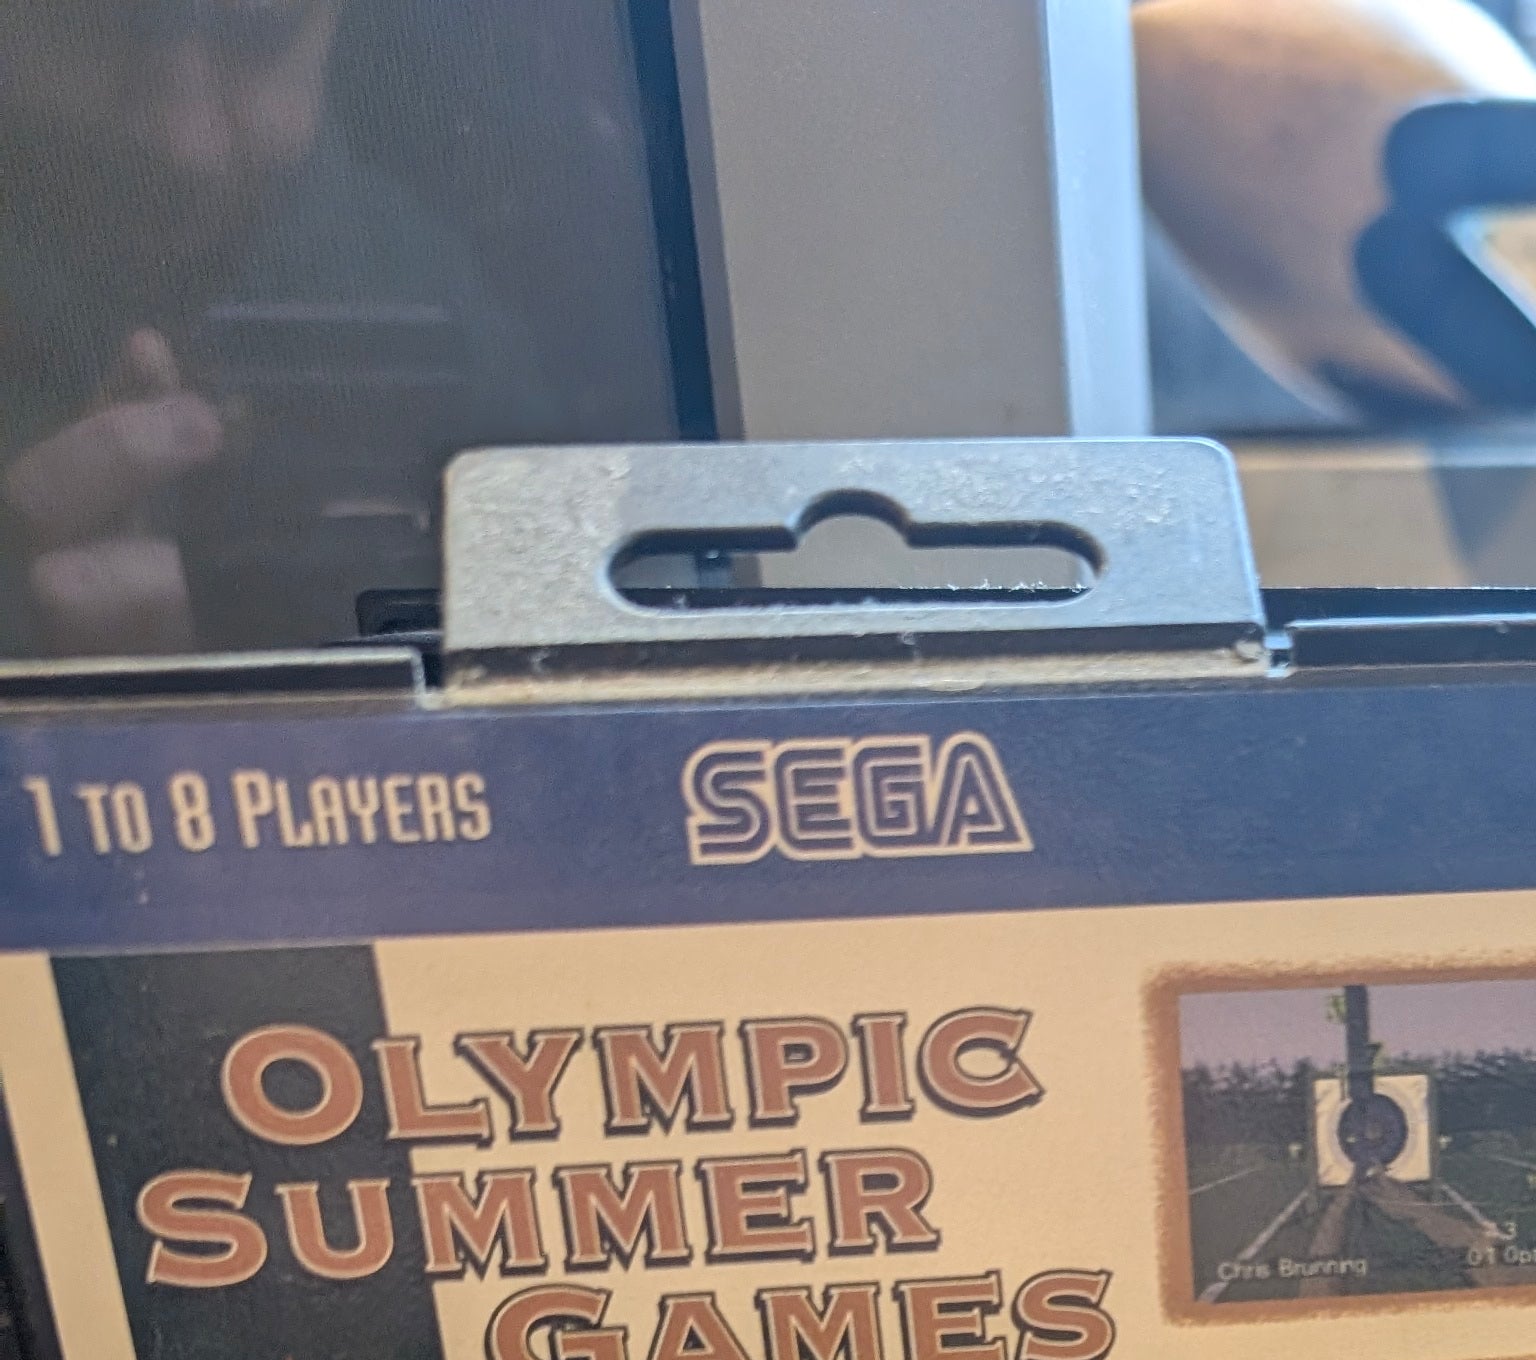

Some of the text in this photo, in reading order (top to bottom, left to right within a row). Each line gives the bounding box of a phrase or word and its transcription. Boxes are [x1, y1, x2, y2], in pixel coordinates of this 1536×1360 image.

[22, 767, 493, 857] 1 TO 8 PLAYERS
[681, 730, 1036, 866] SEGA
[219, 1004, 1045, 1149] OLYMPIC
[136, 1148, 941, 1290] SUMMER
